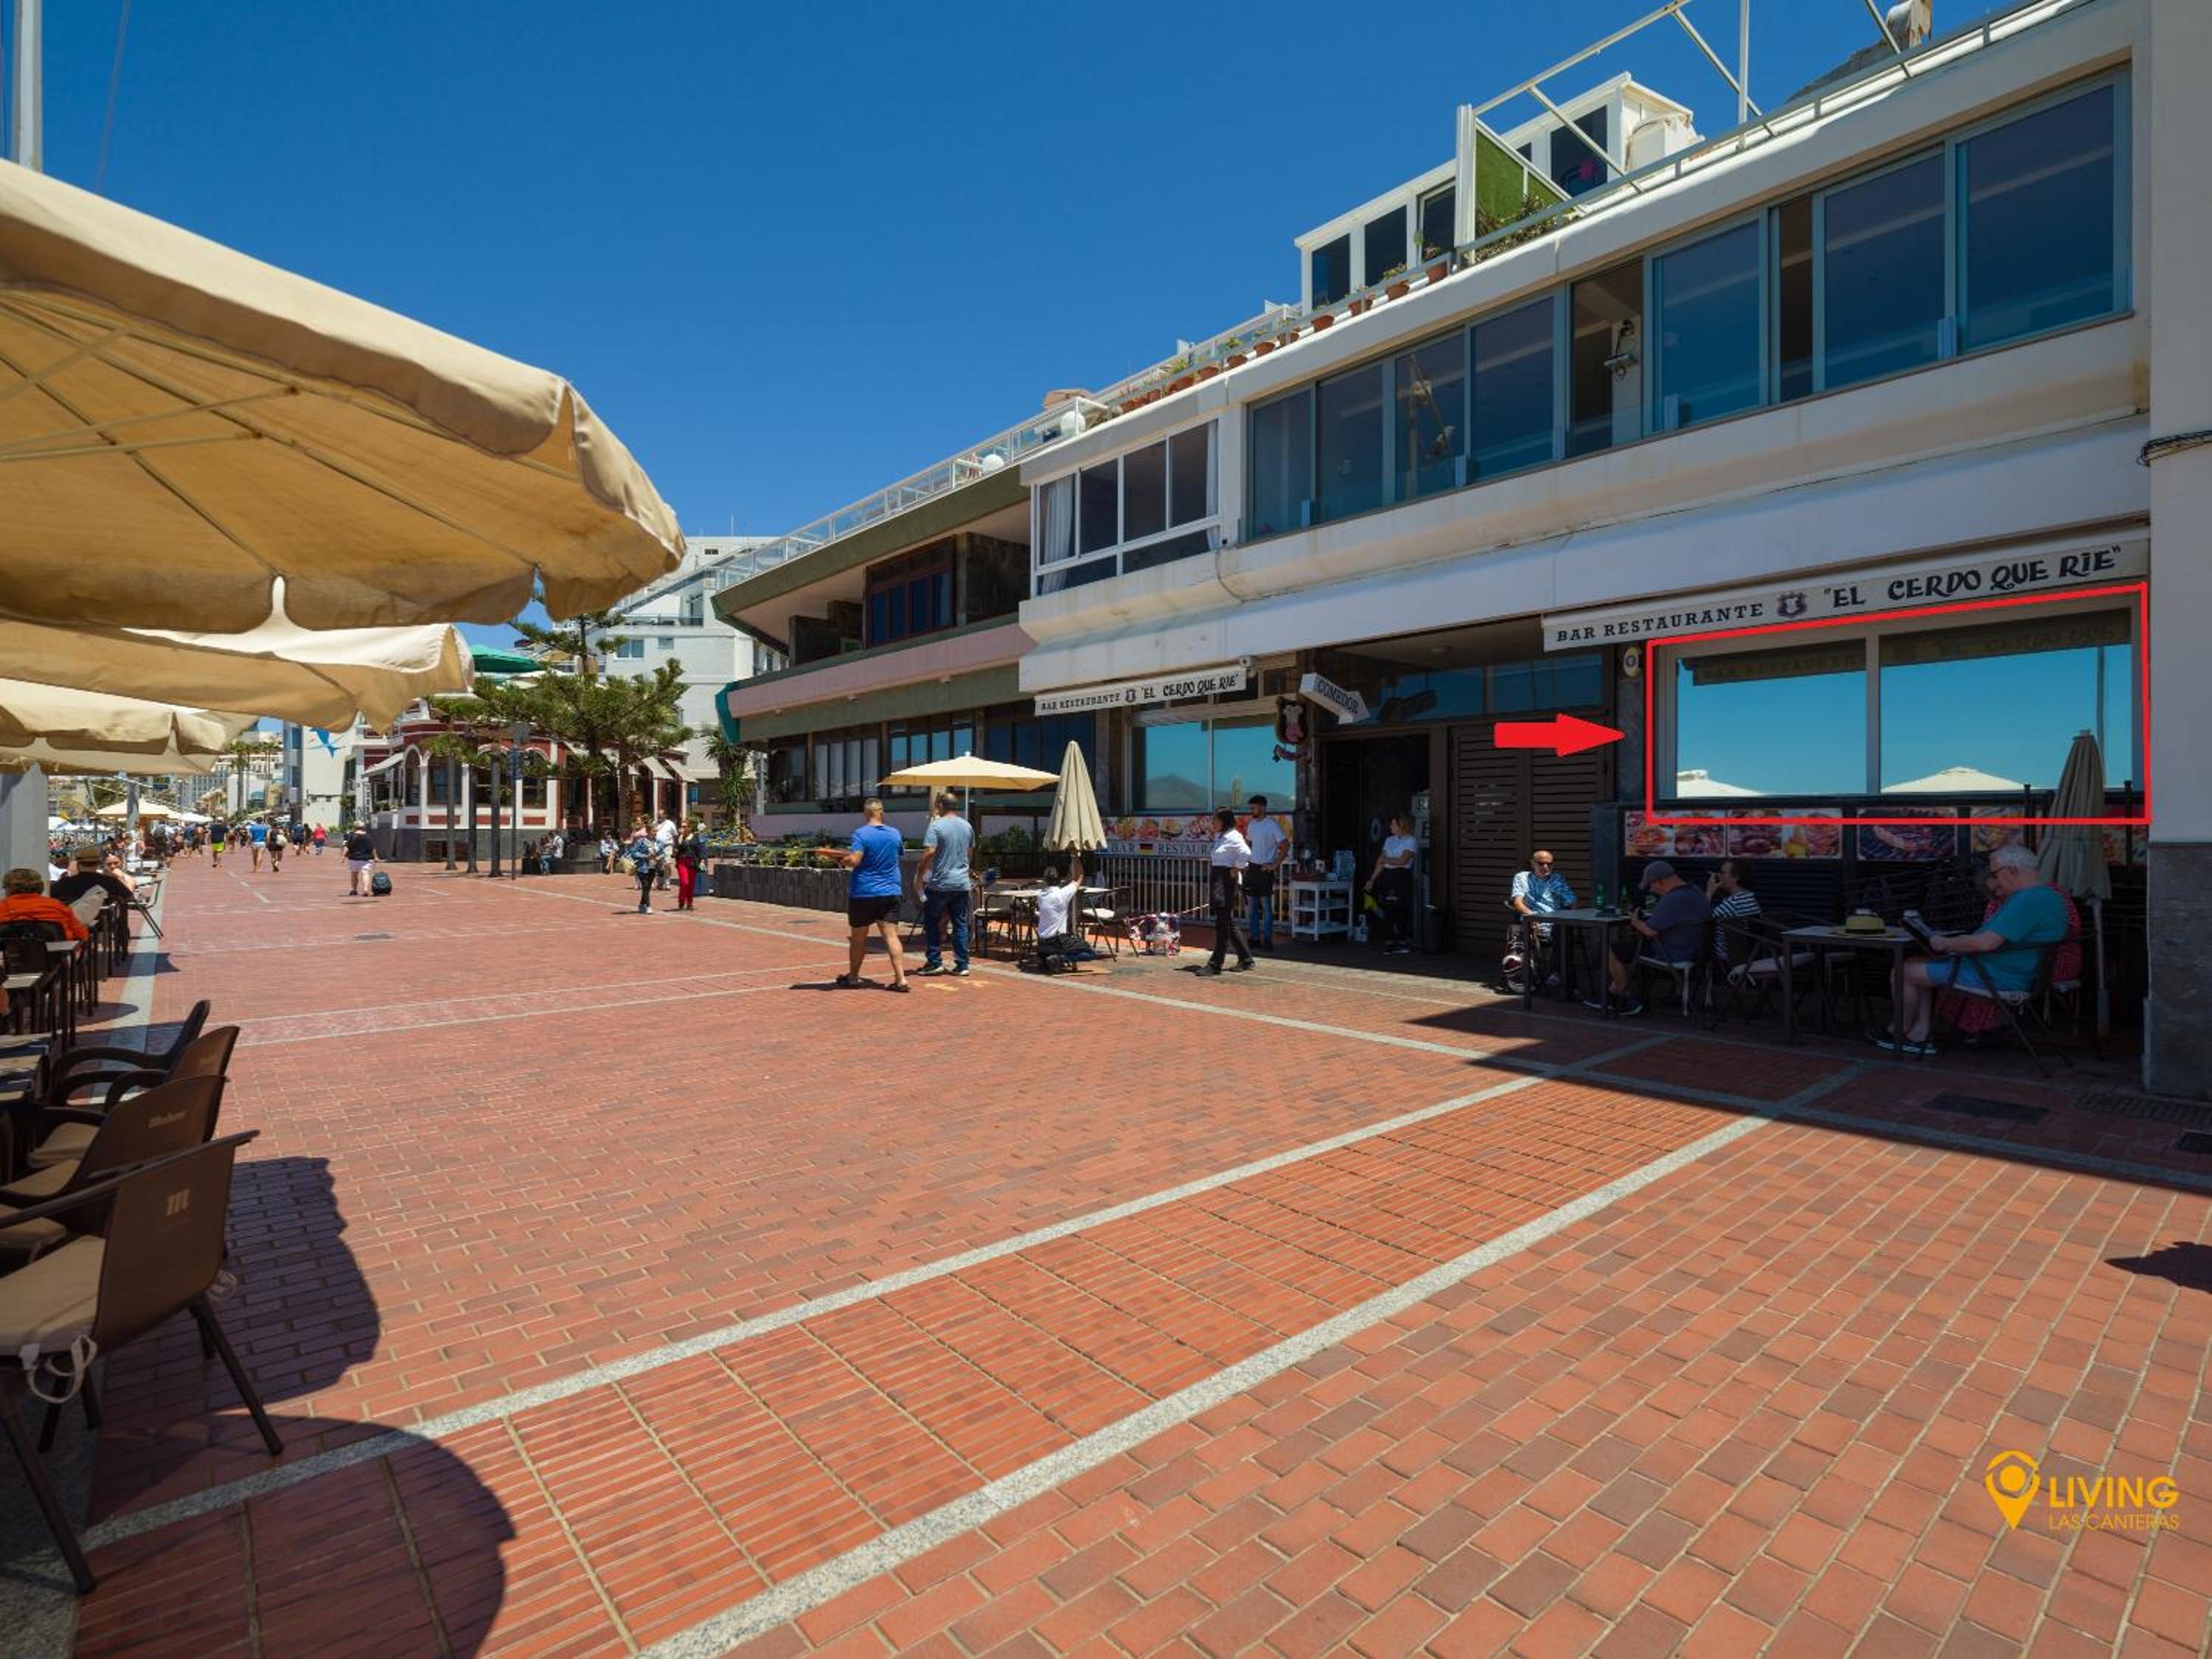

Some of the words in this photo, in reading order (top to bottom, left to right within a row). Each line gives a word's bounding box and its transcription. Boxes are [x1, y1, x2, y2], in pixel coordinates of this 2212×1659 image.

[1557, 625, 1596, 642] BAR
[1604, 602, 1764, 638] RESTAURANTE
[1888, 570, 1983, 601] CERDO
[1991, 560, 2048, 590] QUE
[1040, 702, 1058, 711] BAR
[1060, 692, 1121, 709] RESTAURANTE
[1163, 681, 1195, 697] CERDO
[1197, 678, 1217, 695] QUE
[1318, 678, 1358, 714] COMEDOR
[1111, 842, 1135, 854] BAR
